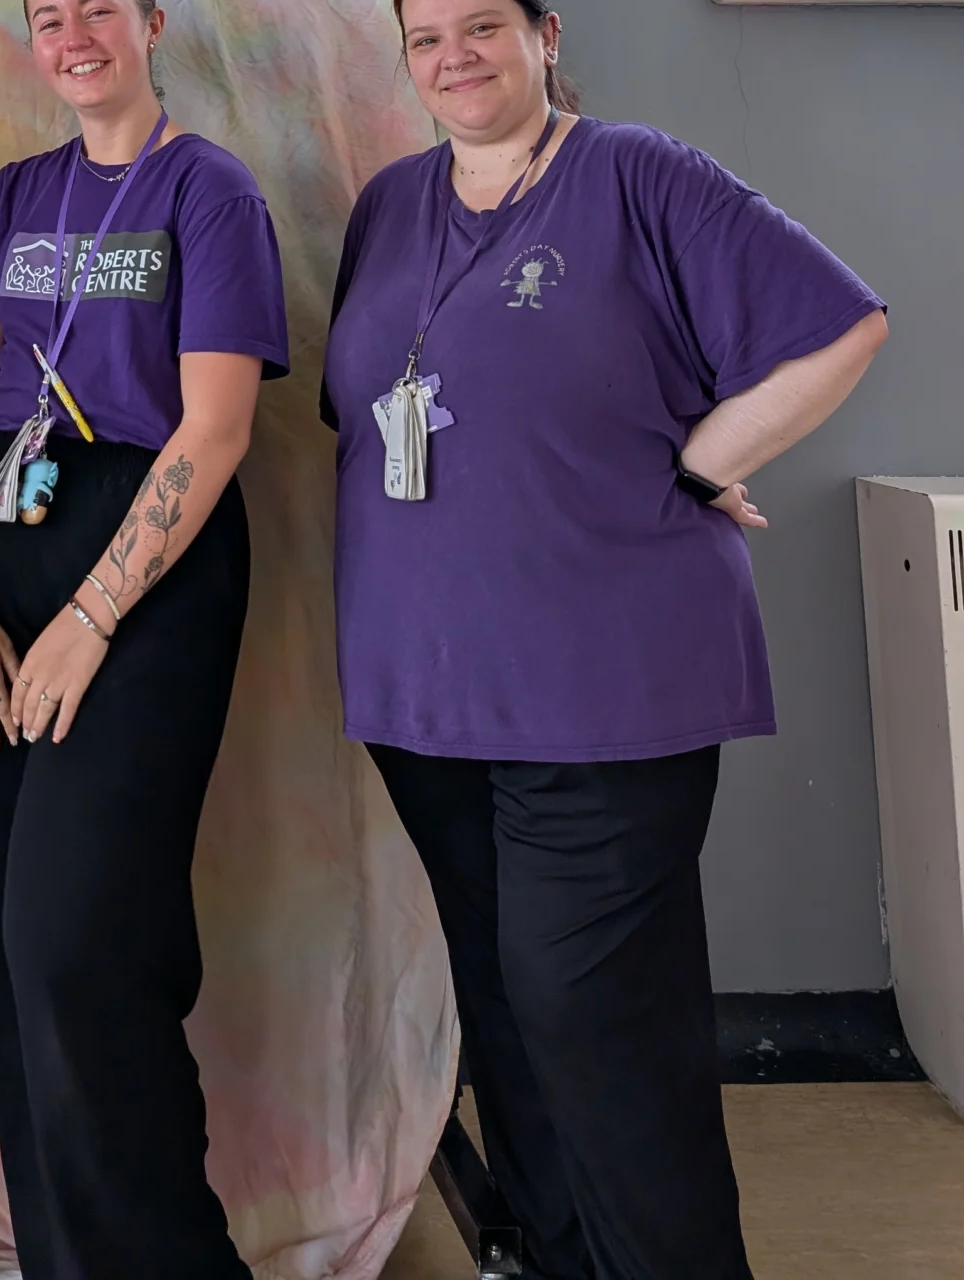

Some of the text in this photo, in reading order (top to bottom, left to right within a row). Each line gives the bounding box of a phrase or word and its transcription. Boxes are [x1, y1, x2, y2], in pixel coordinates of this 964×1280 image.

[80, 240, 96, 251] TH
[530, 244, 550, 252] DAY
[74, 249, 163, 272] ROBERTS
[71, 270, 148, 293] CENTRE
